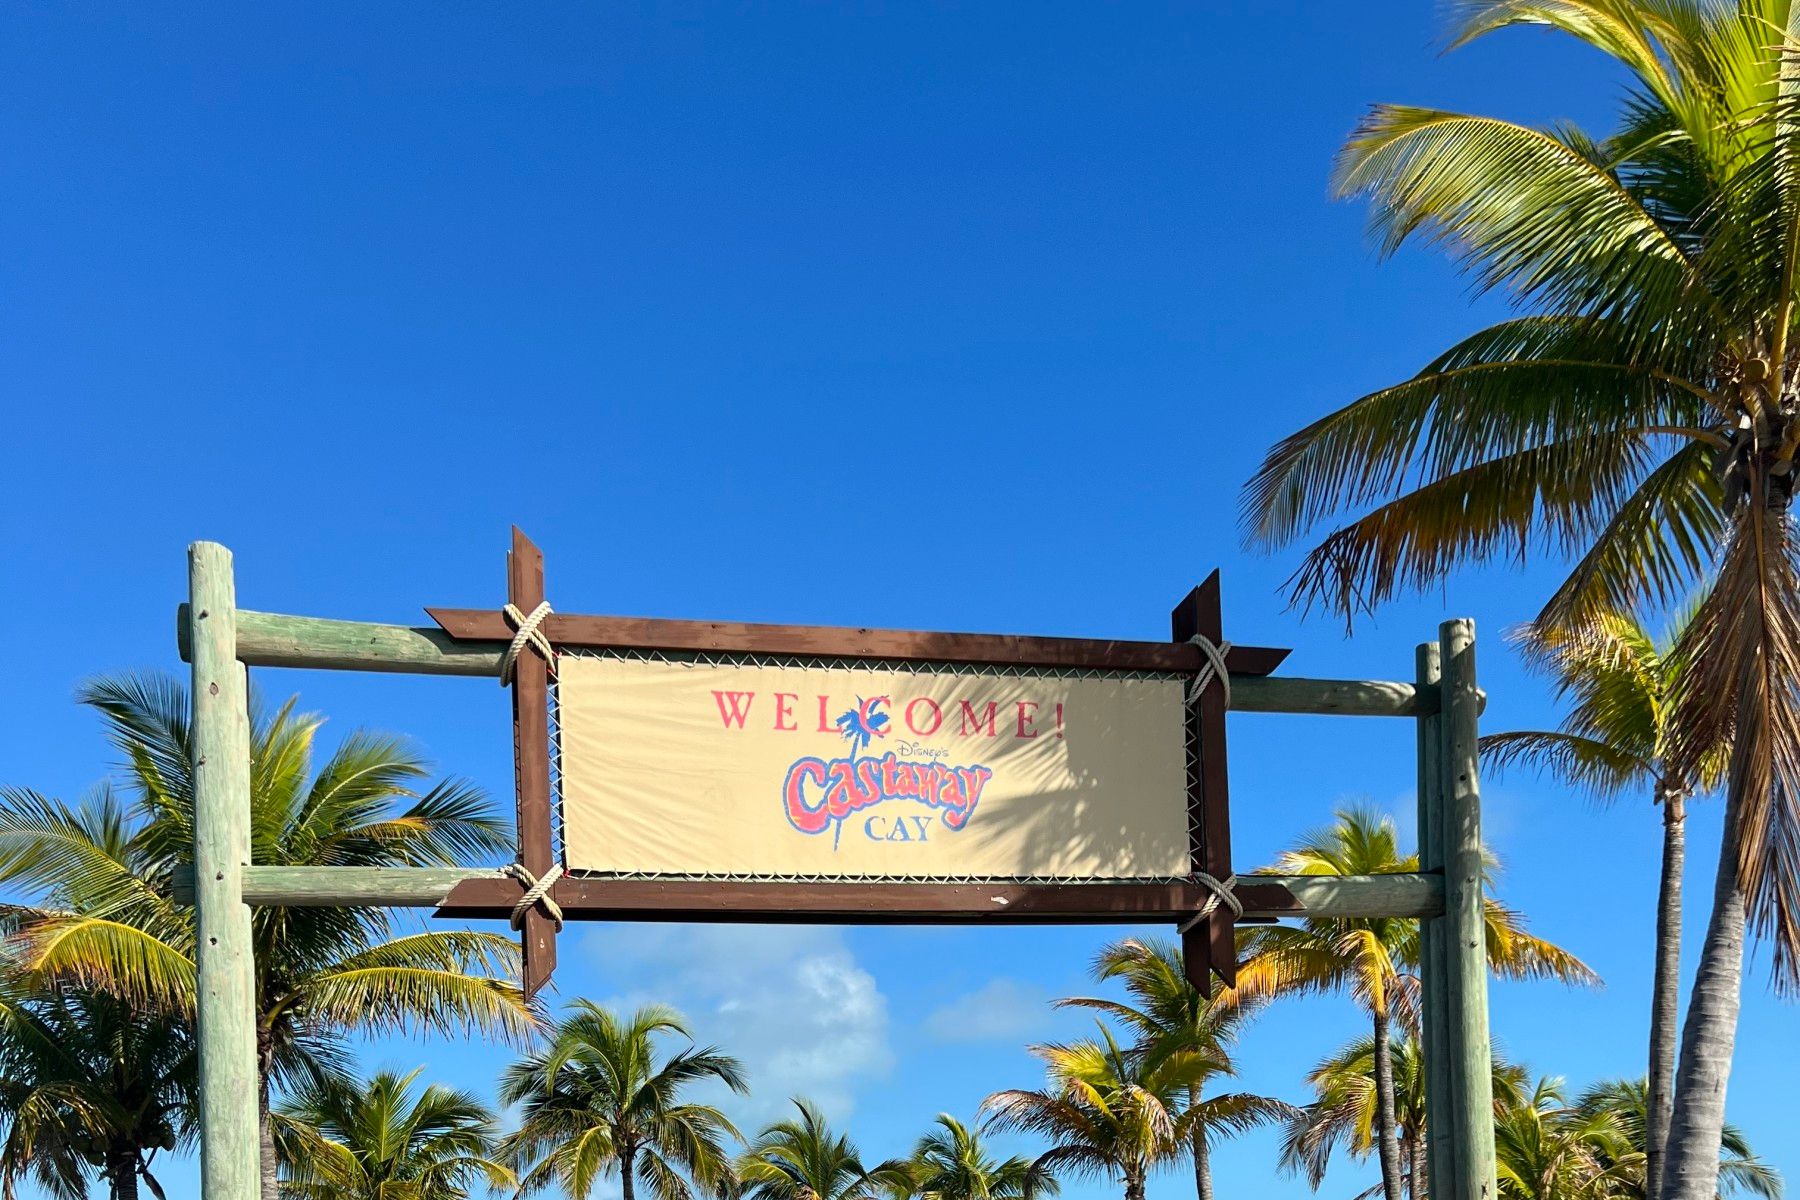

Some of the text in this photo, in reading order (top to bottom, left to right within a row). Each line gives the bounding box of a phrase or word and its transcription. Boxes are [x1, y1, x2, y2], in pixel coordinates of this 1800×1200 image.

[711, 690, 1063, 739] WELCOME!
[783, 752, 992, 832] Castaway
[864, 816, 933, 841] CAY
